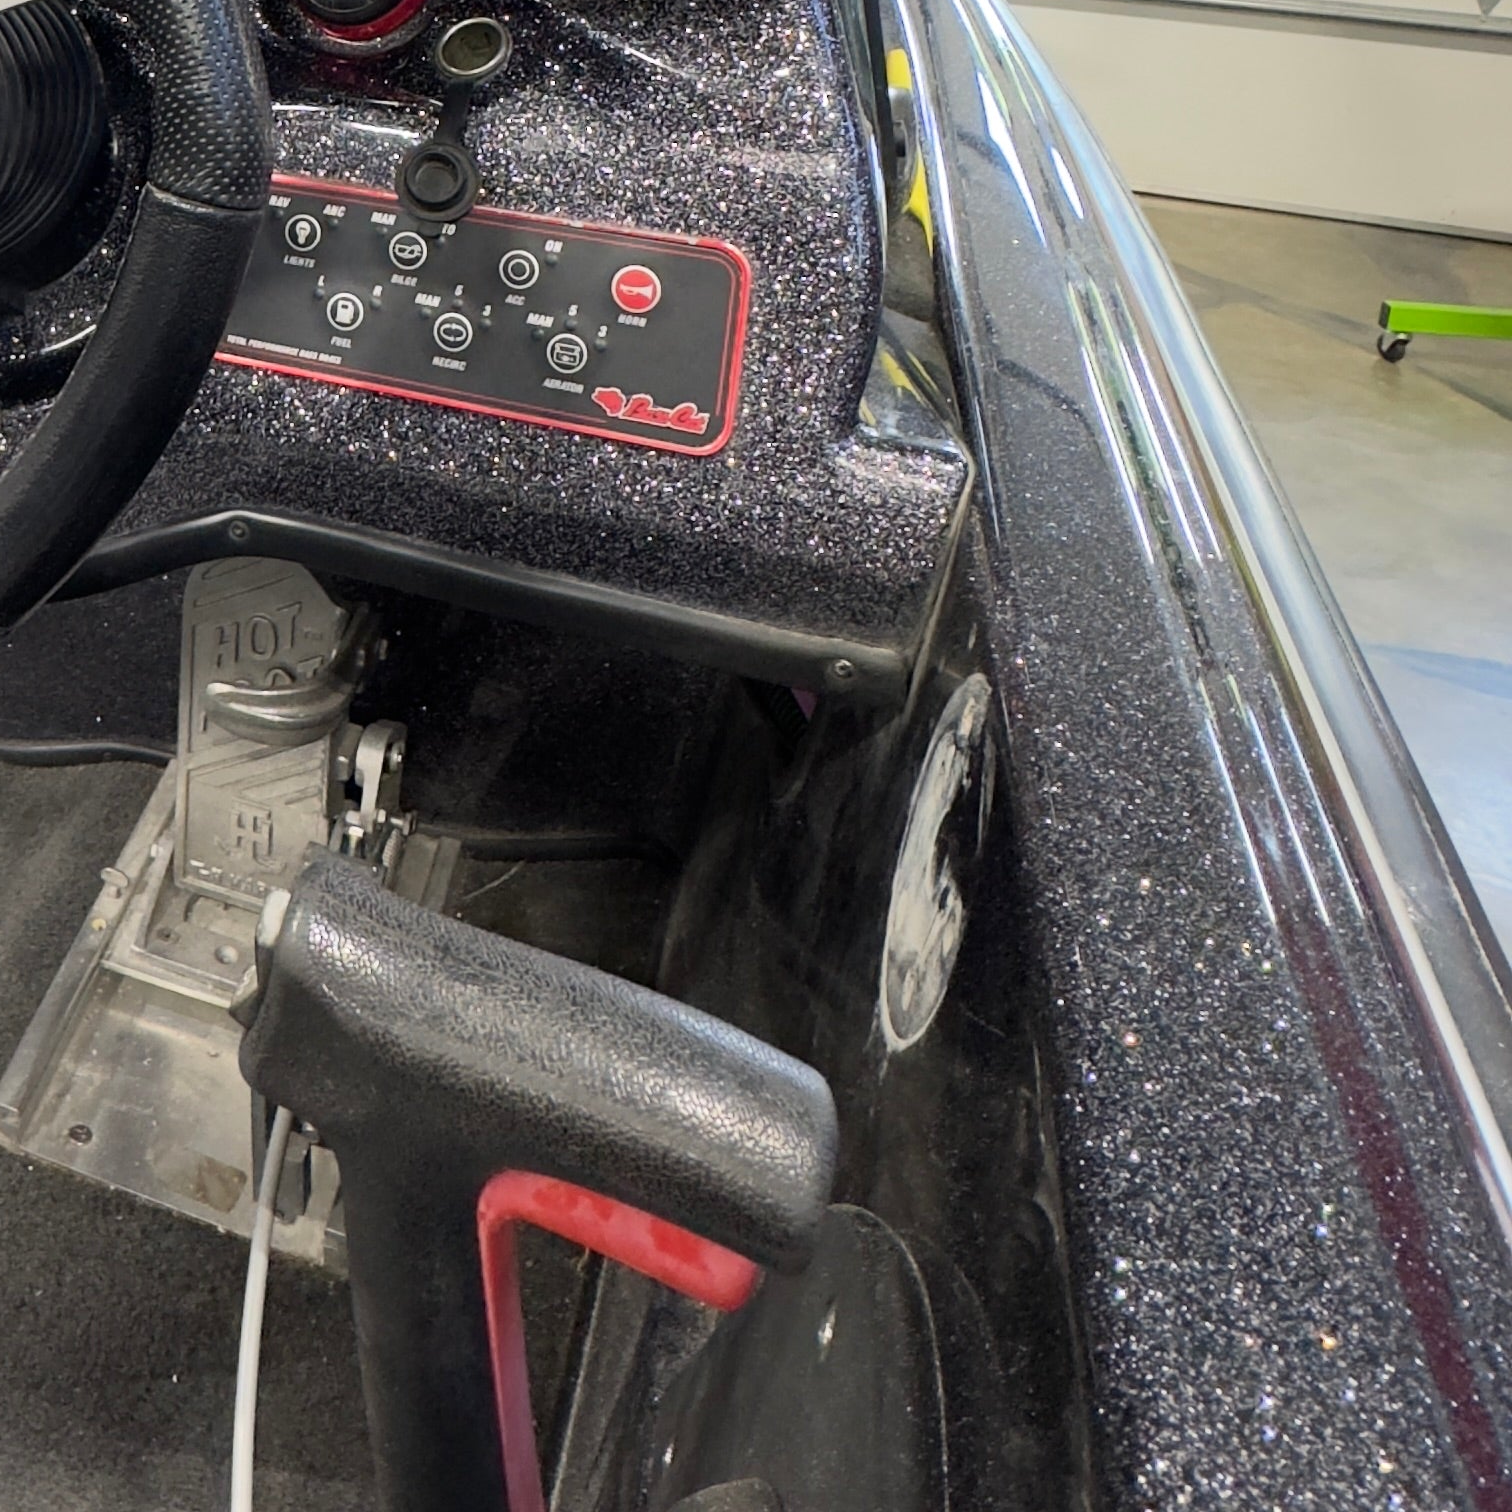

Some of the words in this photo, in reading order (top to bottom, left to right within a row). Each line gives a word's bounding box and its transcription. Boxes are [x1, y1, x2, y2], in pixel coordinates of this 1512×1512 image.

[323, 203, 347, 218] ANC
[370, 211, 397, 226] MAN
[544, 239, 563, 253] ON
[283, 254, 316, 269] LIGHTS
[390, 273, 419, 287] BILGE
[414, 292, 442, 308] MAN
[504, 293, 526, 306] ACC
[526, 312, 554, 328] MAN
[617, 313, 648, 328] HORN
[330, 335, 352, 349] FUEL
[432, 355, 467, 372] RECIRC
[541, 377, 585, 394] AERATOR
[215, 601, 303, 668] HOT
